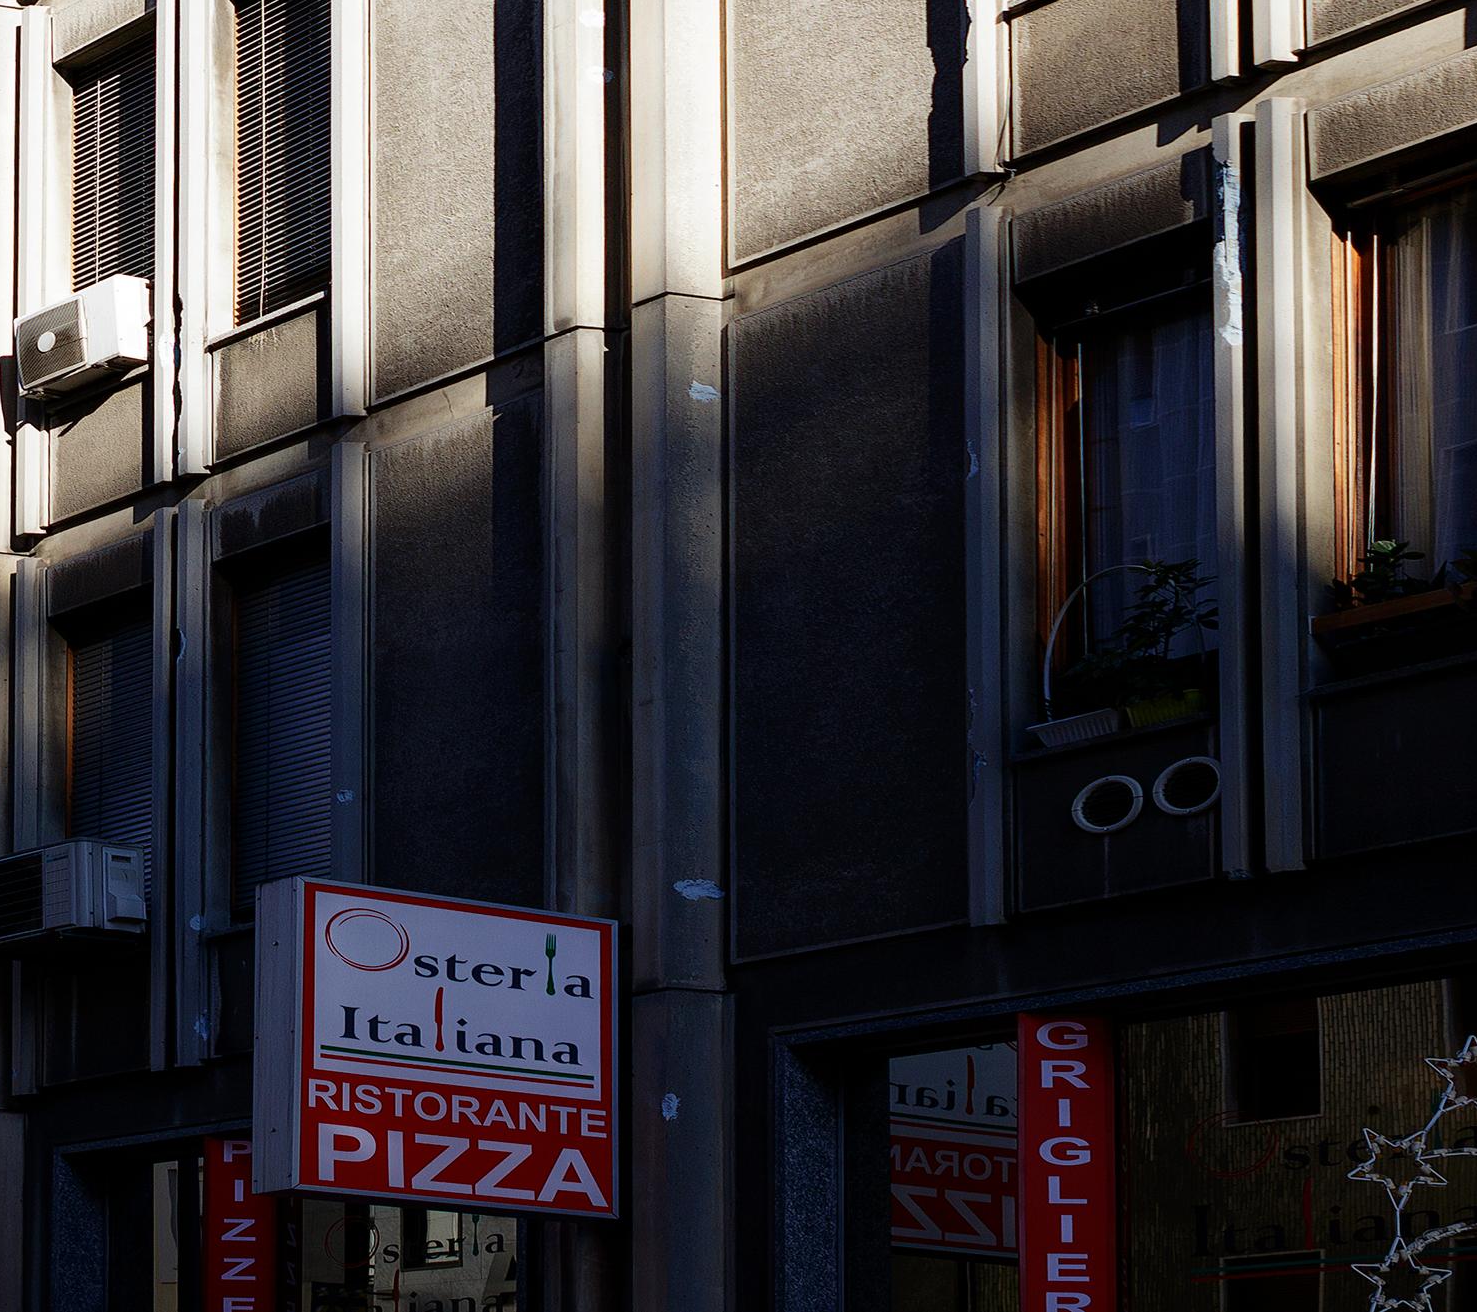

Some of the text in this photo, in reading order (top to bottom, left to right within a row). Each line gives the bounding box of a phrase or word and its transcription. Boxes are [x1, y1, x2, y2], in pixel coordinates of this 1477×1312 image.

[324, 907, 595, 1000] Osteria
[339, 986, 583, 1066] Italiana
[308, 1078, 608, 1139] RISTORANTE
[318, 1123, 609, 1208] PIZZA
